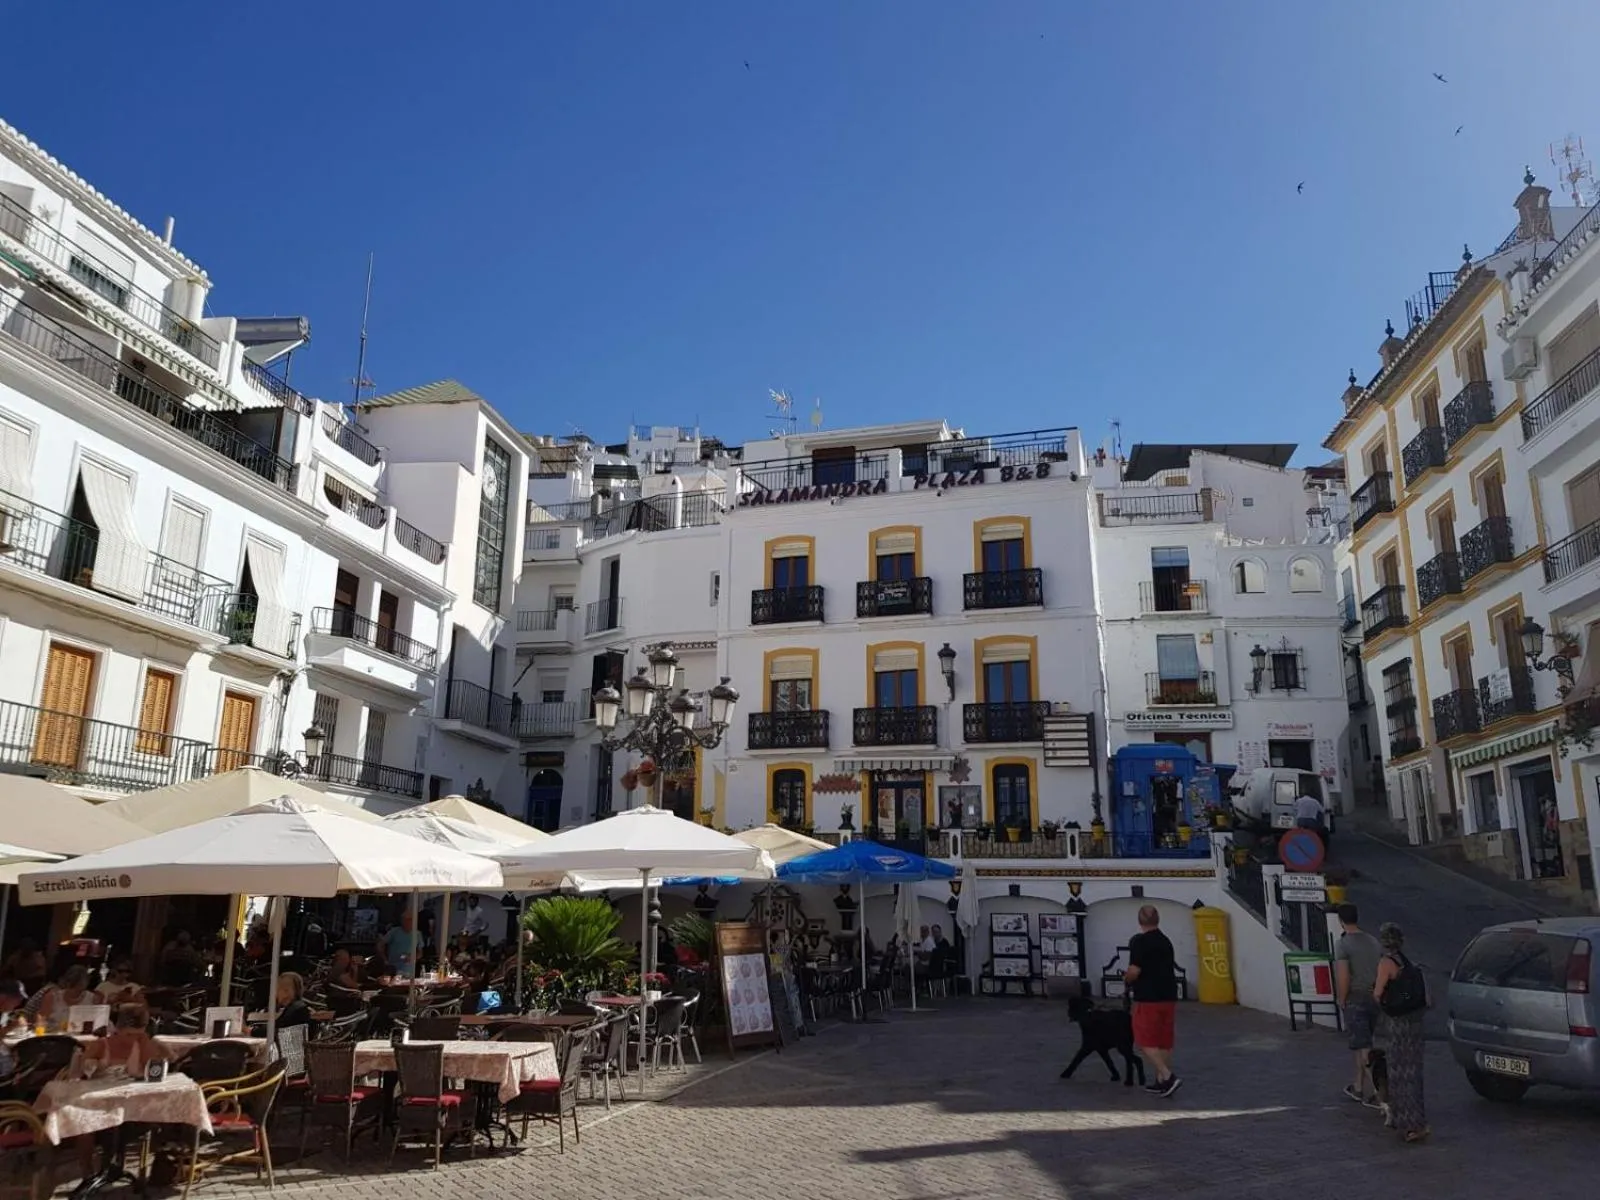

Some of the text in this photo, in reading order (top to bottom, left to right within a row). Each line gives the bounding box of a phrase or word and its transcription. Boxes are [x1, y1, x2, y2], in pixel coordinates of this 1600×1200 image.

[738, 462, 1051, 506] SALAMANDRA PLAZA B&B
[1126, 712, 1173, 721] Oficina
[34, 875, 117, 893] Estrella Galicia
